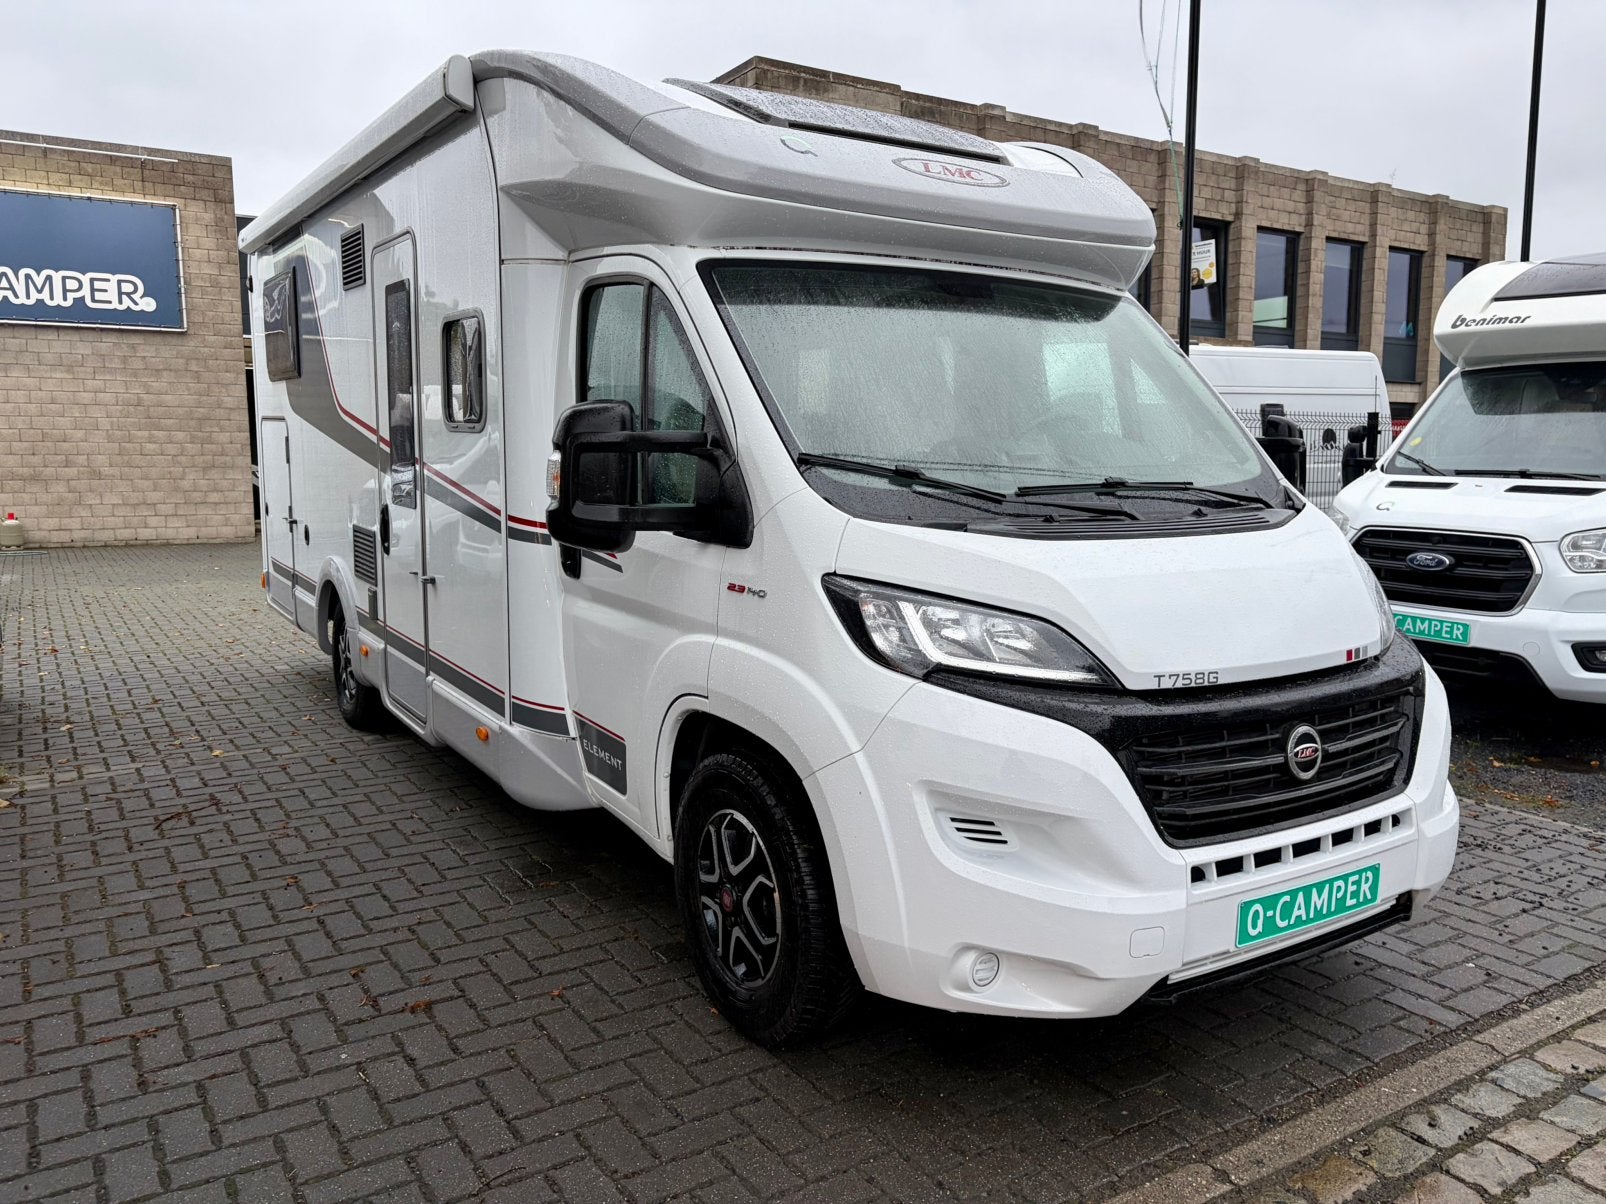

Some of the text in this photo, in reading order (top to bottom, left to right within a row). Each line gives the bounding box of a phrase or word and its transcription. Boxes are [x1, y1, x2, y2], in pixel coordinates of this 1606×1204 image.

[921, 161, 984, 181] LMC
[1451, 314, 1532, 329] benimar
[1413, 554, 1438, 567] Ford
[1394, 615, 1464, 640] CAMPER
[583, 739, 622, 771] ELEMENT
[1247, 870, 1374, 937] Q-CAMPER
